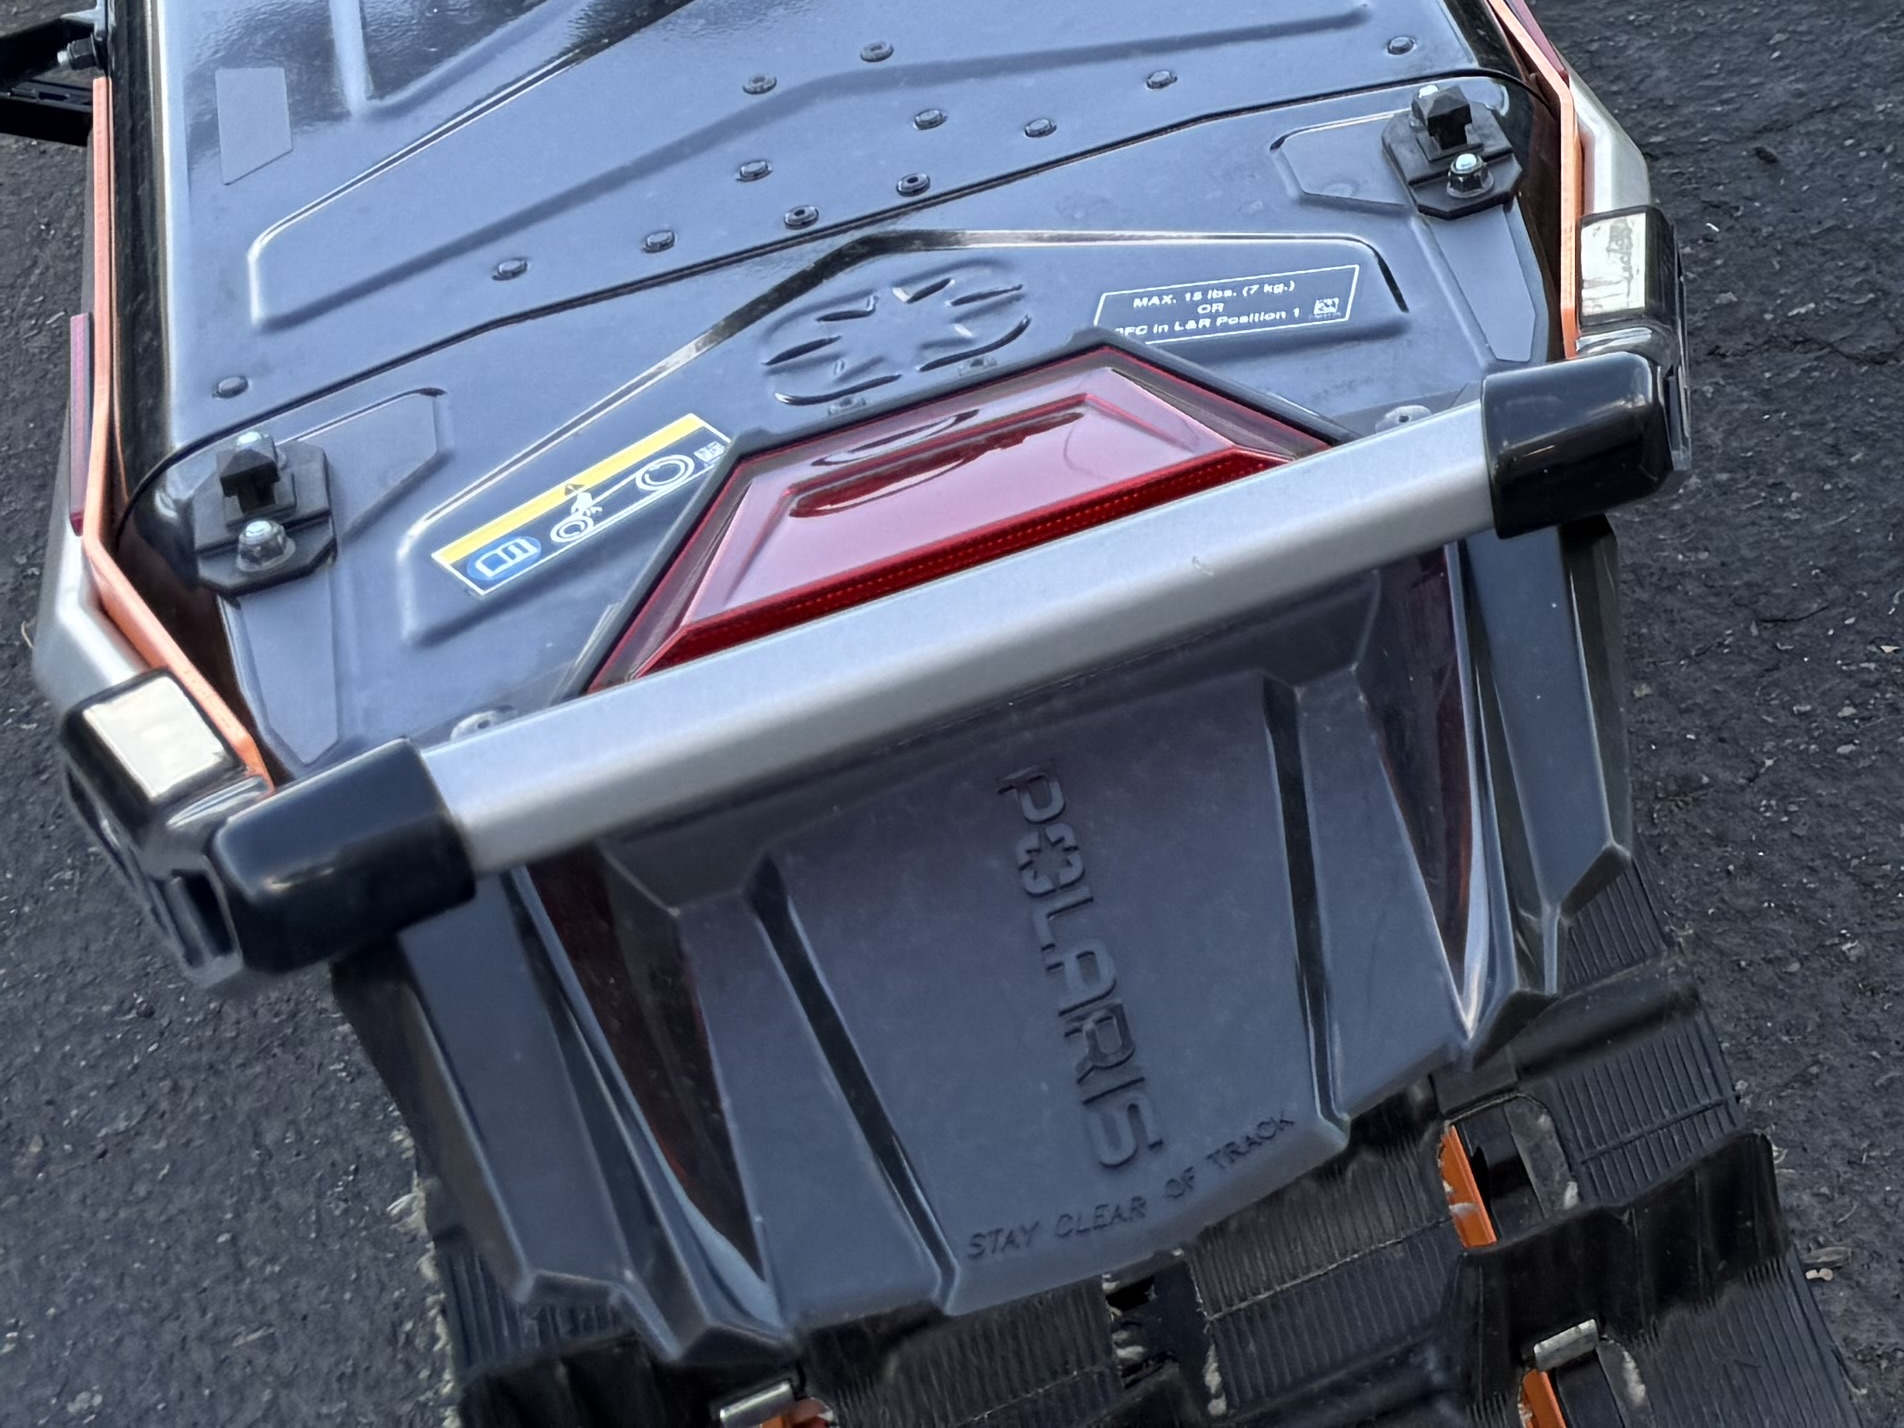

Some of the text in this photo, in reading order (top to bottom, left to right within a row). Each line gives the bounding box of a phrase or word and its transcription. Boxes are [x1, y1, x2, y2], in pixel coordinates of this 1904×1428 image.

[1133, 294, 1177, 308] MAX.
[1207, 289, 1237, 300] lbs.
[1197, 303, 1225, 314] OR
[1174, 318, 1211, 331] L&R
[1216, 311, 1287, 326] Position
[997, 764, 1165, 1170] POLARIS
[966, 1109, 1296, 1260] STAY CLEAR OF TRACK
